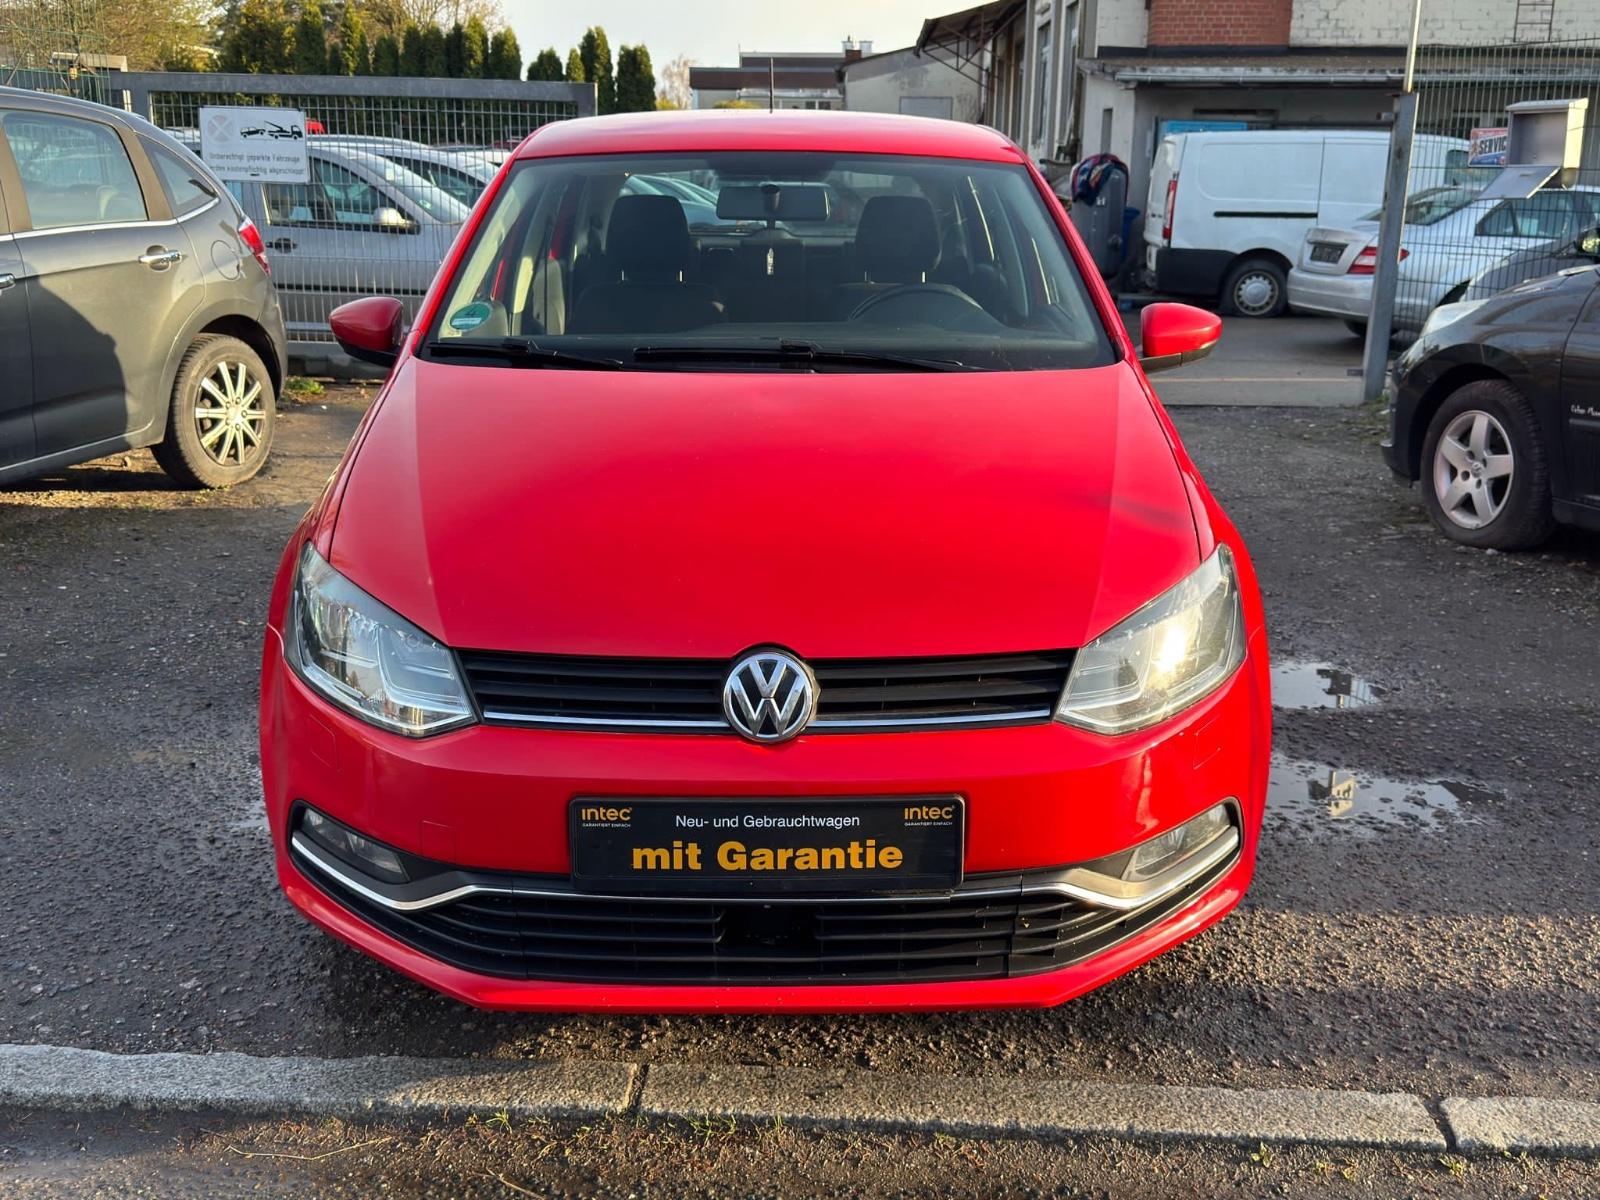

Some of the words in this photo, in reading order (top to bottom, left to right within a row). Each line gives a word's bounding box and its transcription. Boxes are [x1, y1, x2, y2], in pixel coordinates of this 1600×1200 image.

[1478, 135, 1507, 155] SERVIC
[675, 815, 708, 828] Neu-
[713, 815, 739, 828] und
[743, 814, 860, 830] Gebrauchtwagen
[632, 840, 702, 871] mit
[717, 838, 904, 871] Garantie
